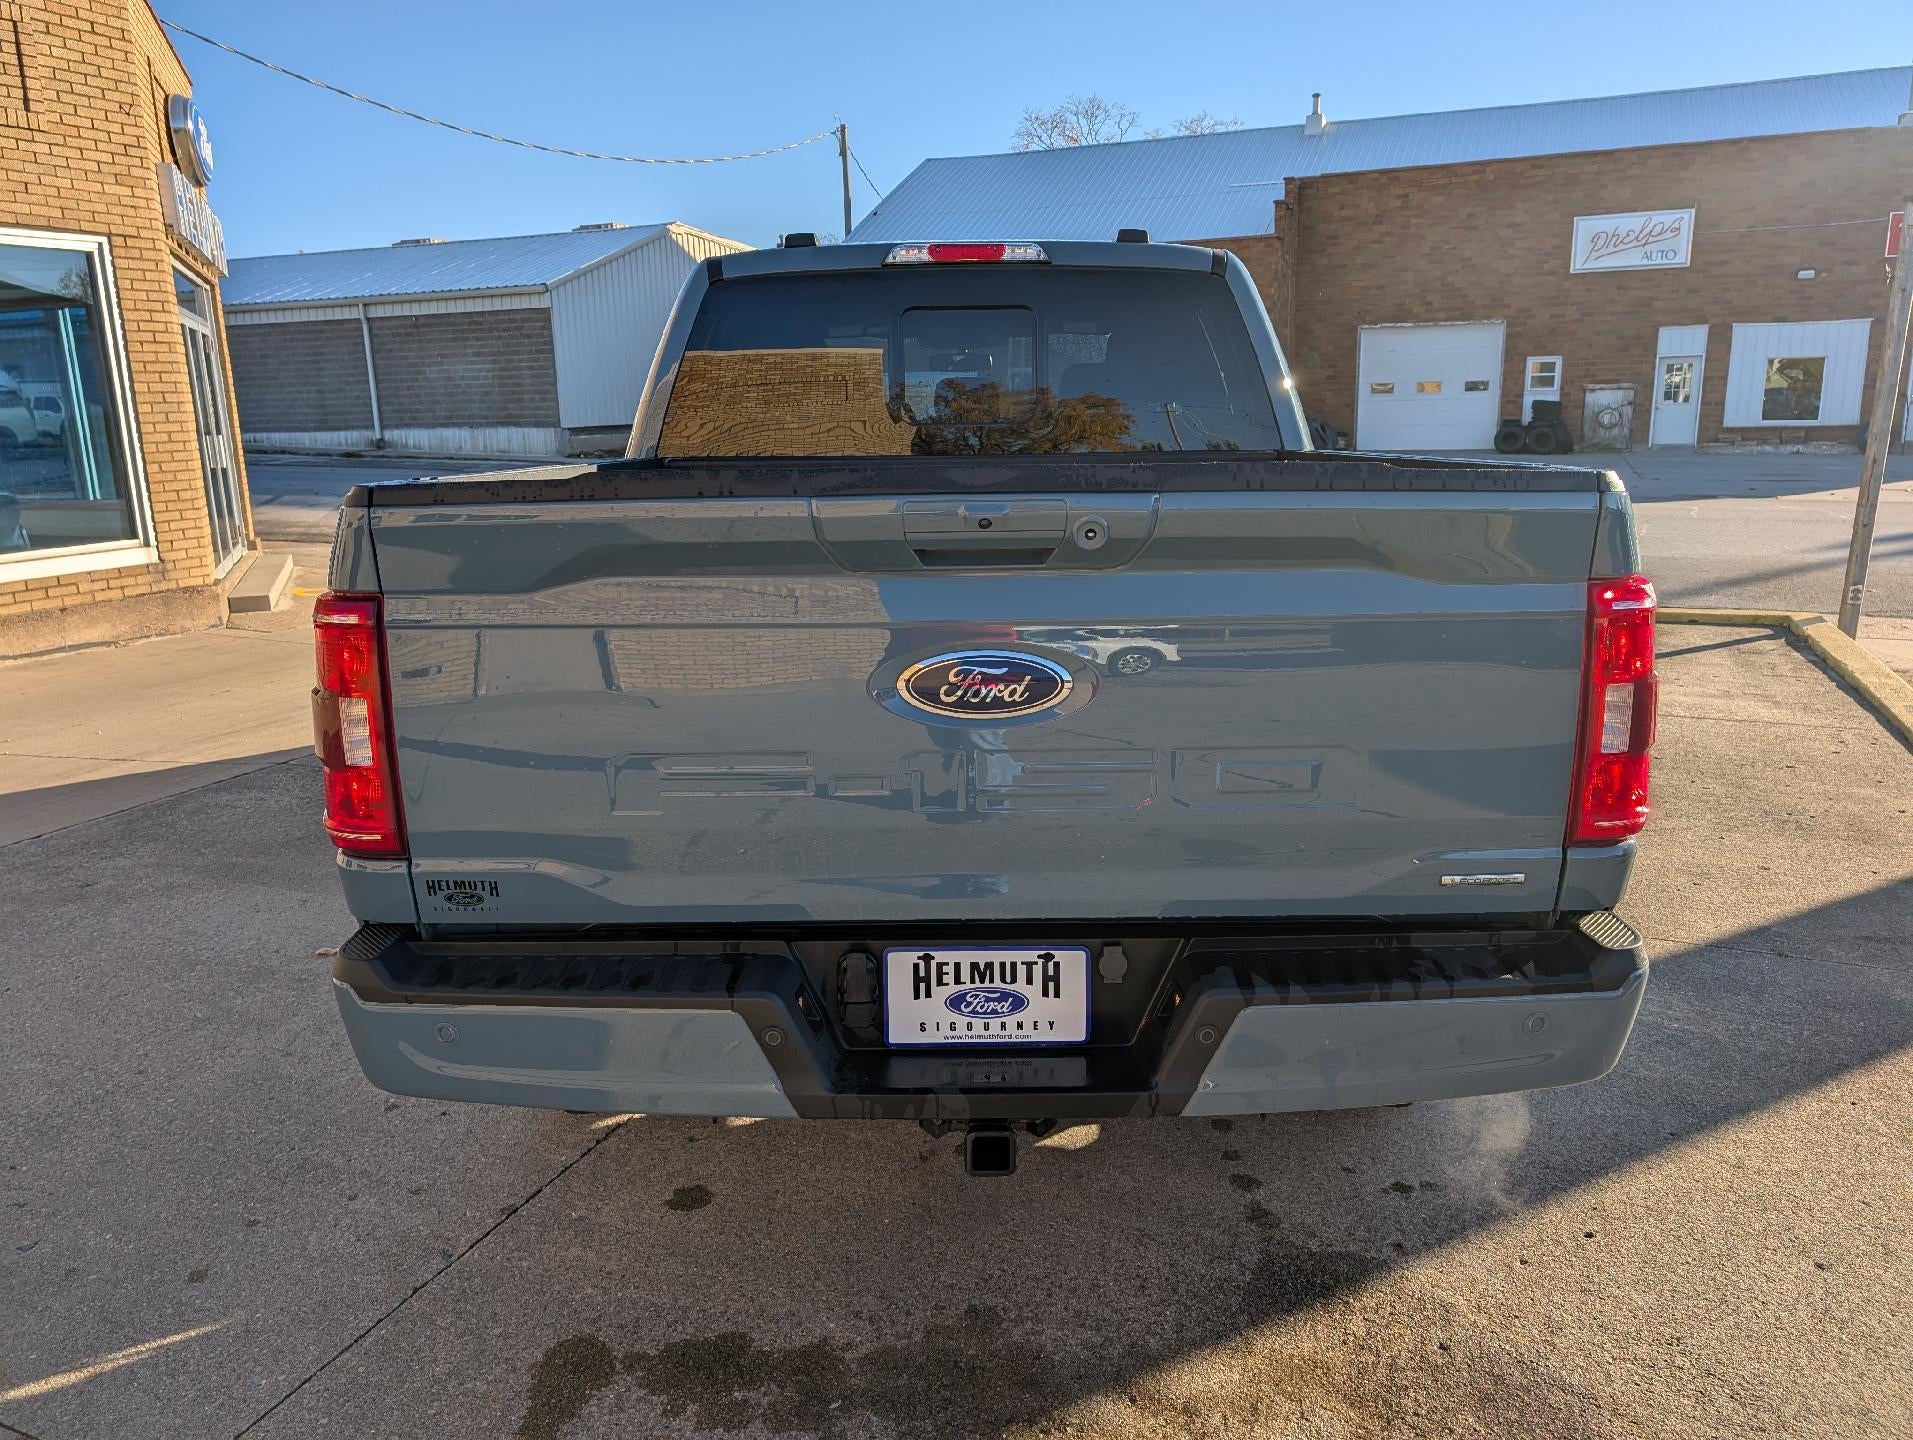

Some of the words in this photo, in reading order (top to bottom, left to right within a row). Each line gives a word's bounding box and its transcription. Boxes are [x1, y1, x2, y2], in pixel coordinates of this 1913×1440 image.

[1581, 216, 1684, 267] Phelps
[1640, 248, 1678, 263] AUTO
[939, 665, 1032, 703] Ford
[425, 879, 500, 897] HELMUTH
[912, 953, 1061, 1000] HELMUTH
[960, 991, 1013, 1013] Ford
[919, 1020, 1055, 1032] SIGOURNEY
[943, 1033, 1032, 1041] www.helmuthford.com
